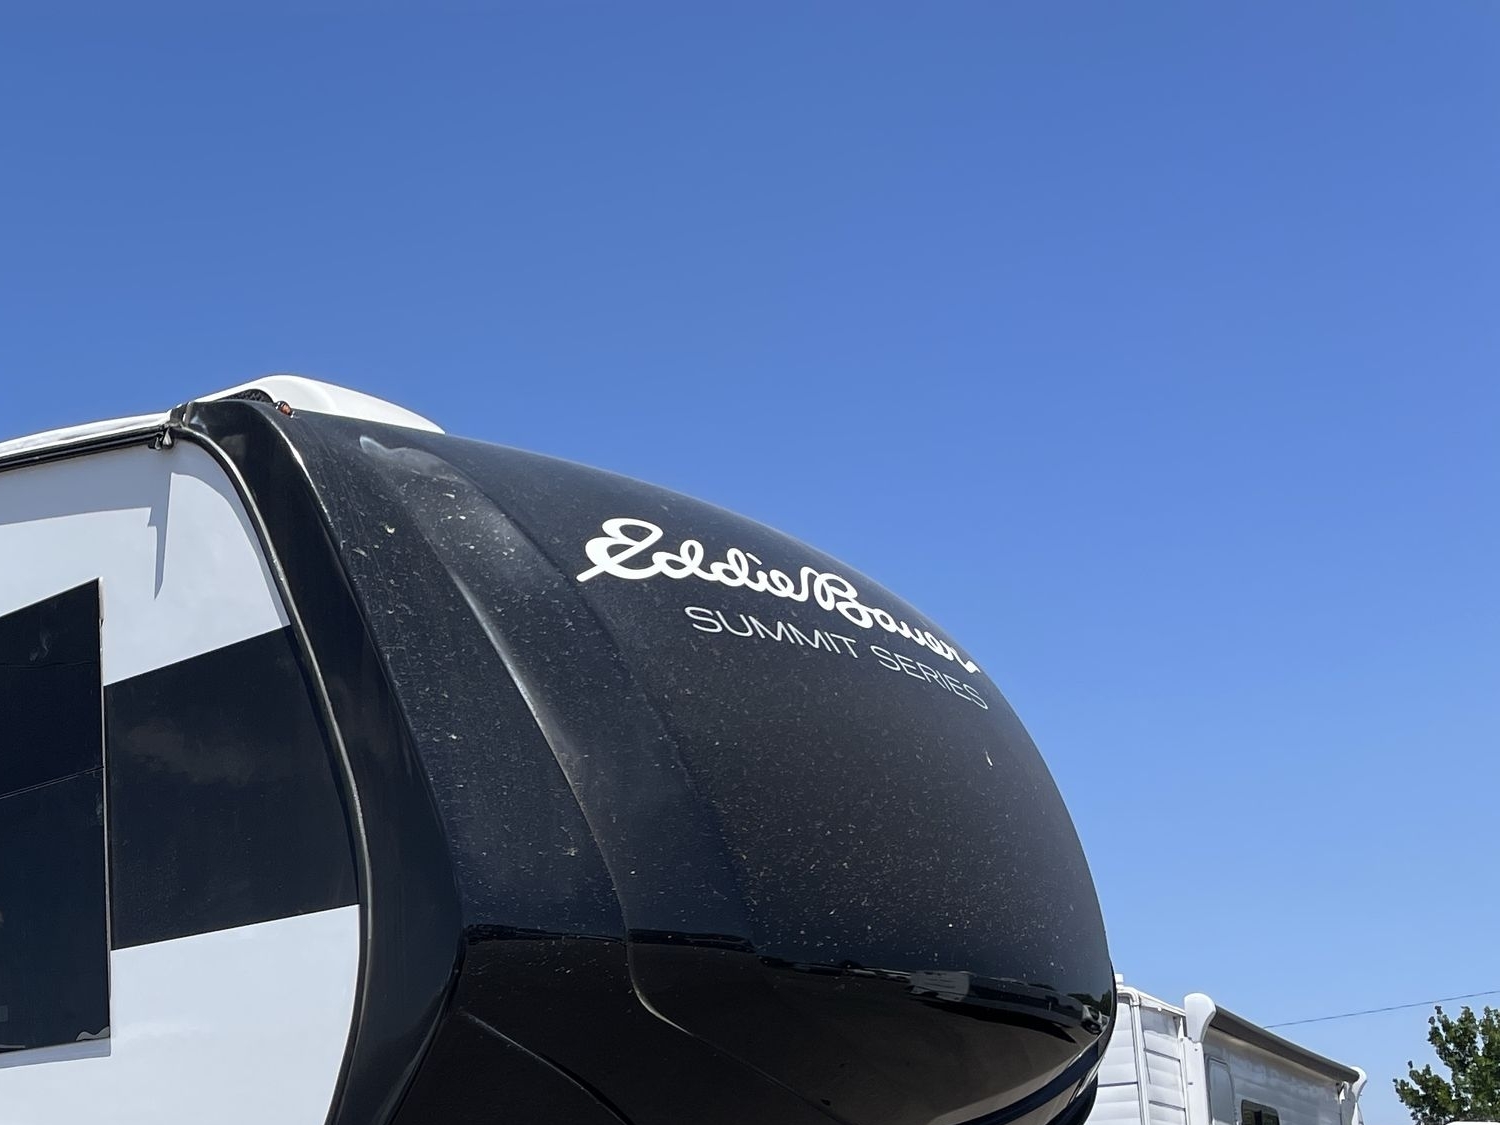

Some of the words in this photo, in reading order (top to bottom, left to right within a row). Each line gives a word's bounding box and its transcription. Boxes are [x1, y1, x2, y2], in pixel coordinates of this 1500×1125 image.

[576, 517, 803, 601] Eddie
[802, 566, 981, 675] Bauer
[684, 606, 858, 659] SUMMIT
[870, 645, 989, 710] SERIES
